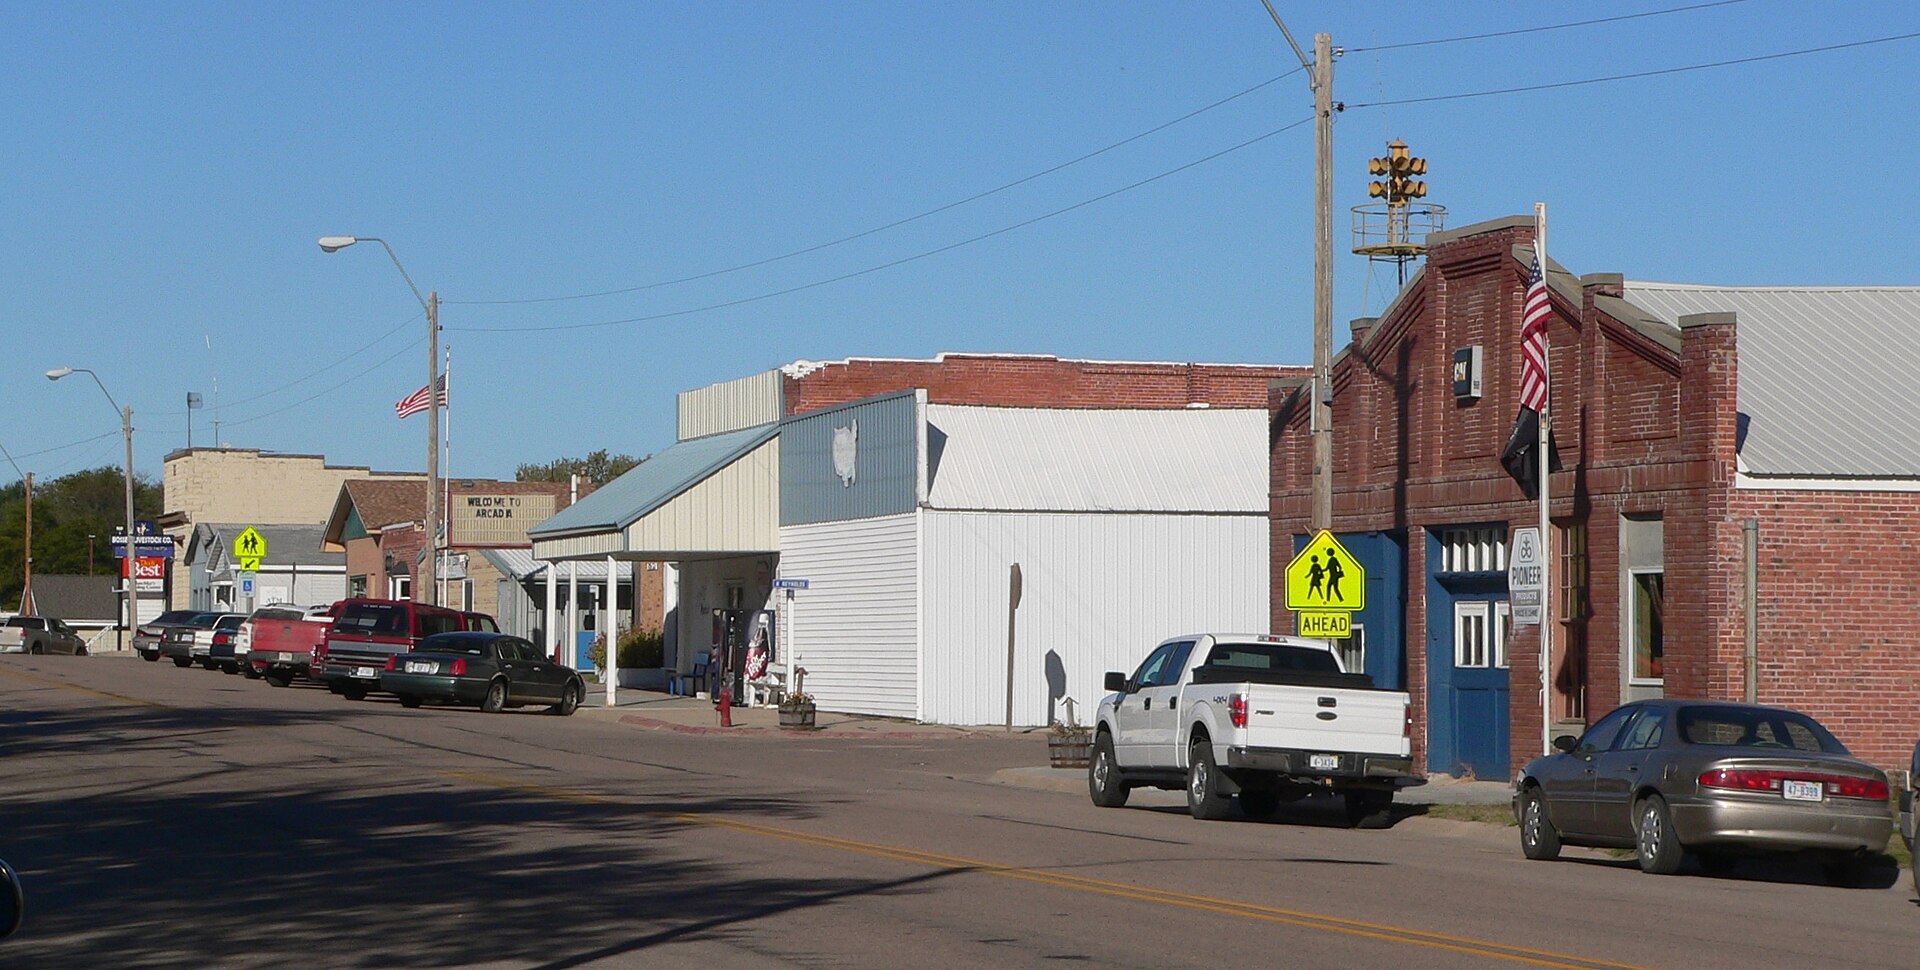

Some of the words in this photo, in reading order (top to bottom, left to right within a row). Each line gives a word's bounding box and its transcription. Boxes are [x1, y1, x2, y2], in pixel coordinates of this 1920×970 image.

[1454, 361, 1467, 382] CAT
[467, 497, 505, 507] WELCOME
[509, 497, 521, 507] TO
[476, 508, 513, 519] ARCADIA
[1512, 566, 1542, 586] PIONEER
[1515, 591, 1537, 601] PRODUCTS
[1302, 616, 1348, 632] AHEAD
